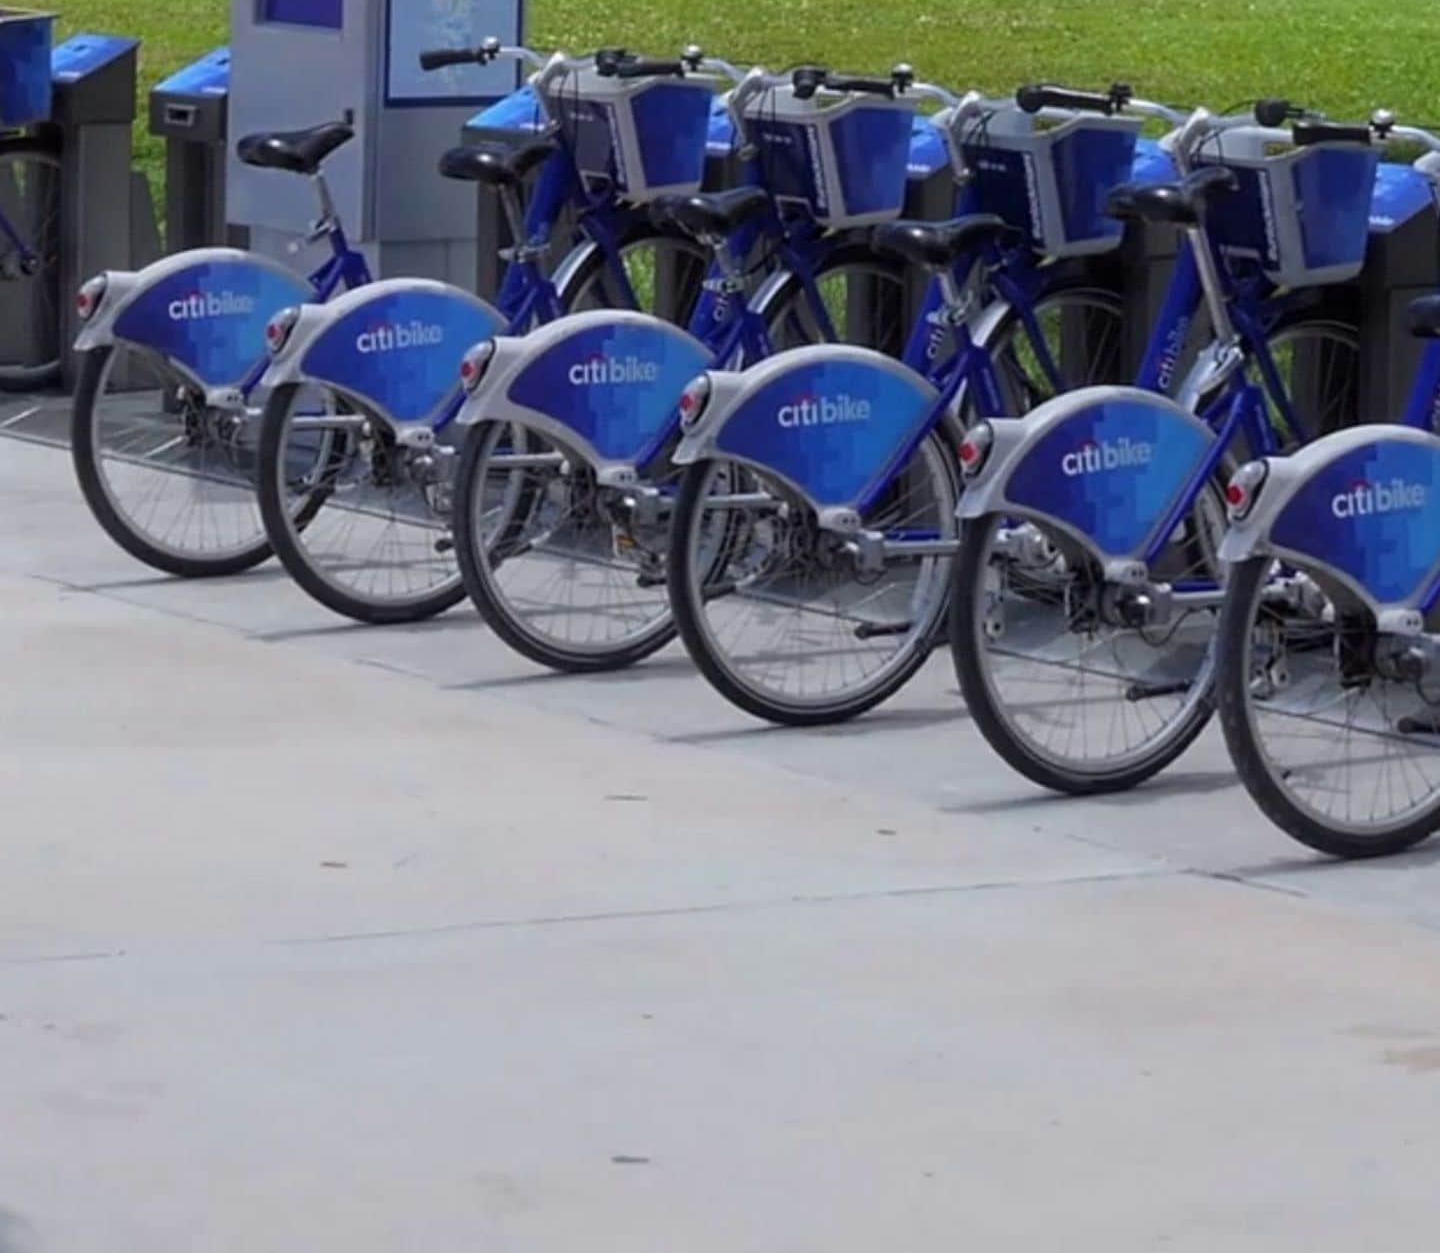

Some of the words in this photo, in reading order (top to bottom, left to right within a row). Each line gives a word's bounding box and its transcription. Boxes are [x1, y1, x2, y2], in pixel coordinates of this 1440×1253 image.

[169, 295, 205, 319] citi
[357, 326, 393, 353] citi
[569, 359, 607, 385] citi
[609, 355, 657, 383] bike
[778, 399, 818, 427] citi
[821, 394, 871, 423] bike
[1062, 444, 1101, 476] citi
[1102, 437, 1151, 469] bike
[1332, 485, 1373, 518] citi
[1375, 478, 1425, 511] bike
